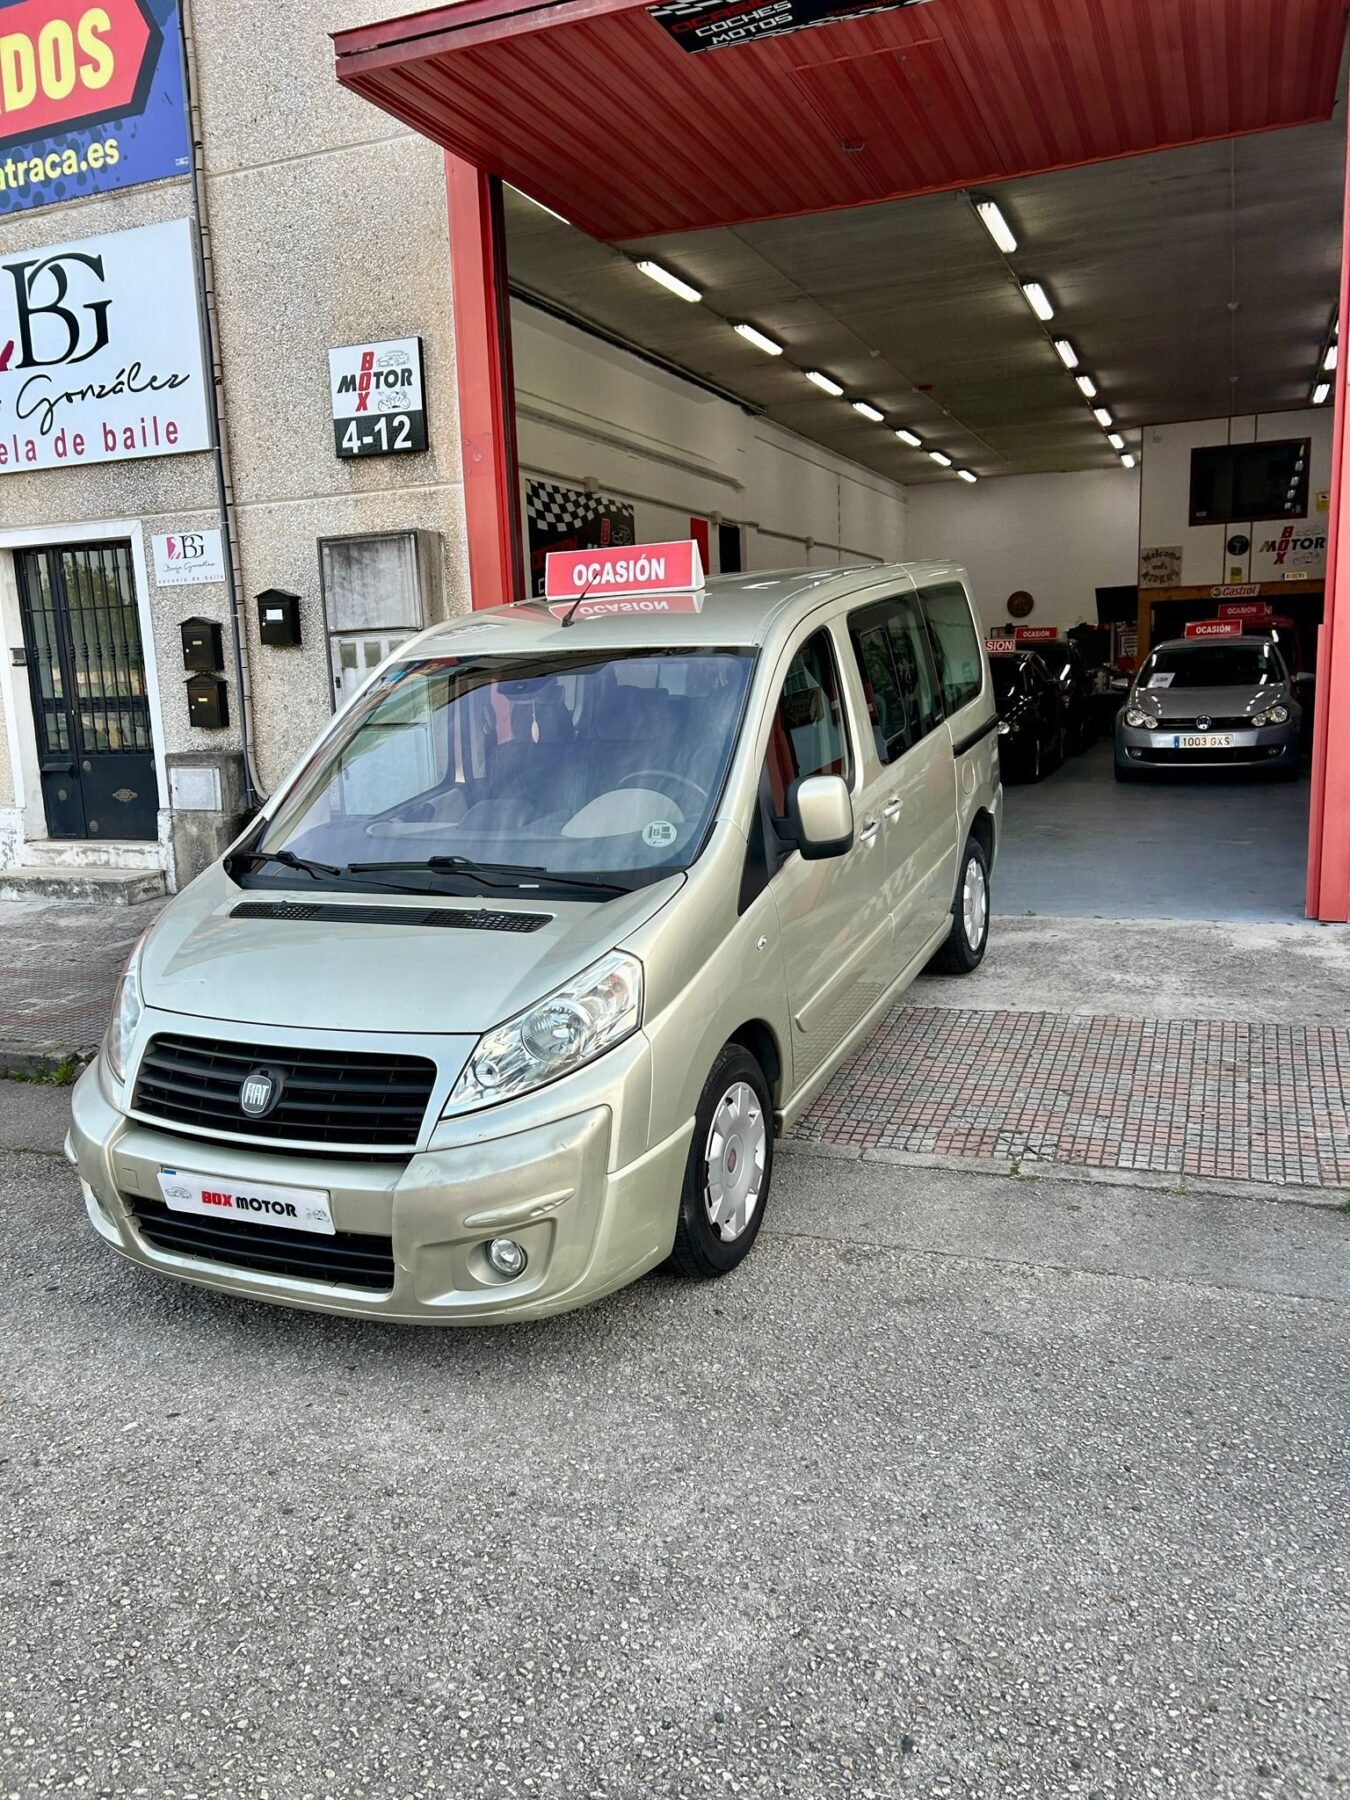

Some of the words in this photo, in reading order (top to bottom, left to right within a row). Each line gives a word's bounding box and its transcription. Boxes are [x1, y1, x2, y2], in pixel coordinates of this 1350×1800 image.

[695, 0, 792, 37] COCHES
[712, 12, 793, 45] MOTOS
[337, 369, 413, 394] MOTOR
[355, 351, 374, 412] BOX
[16, 361, 190, 435] González
[54, 428, 85, 458] de
[102, 416, 179, 452] baile
[342, 416, 412, 453] 4-12
[1259, 537, 1326, 553] MOTOR
[572, 554, 666, 587] OCASIÓN
[1222, 586, 1258, 597] Castrol
[1195, 624, 1232, 634] OCASIÓN
[1182, 736, 1207, 746] 1003
[1210, 736, 1230, 746] GXS
[244, 1083, 269, 1106] FIAT
[201, 1190, 233, 1207] BOX
[236, 1196, 297, 1218] MOTOR
